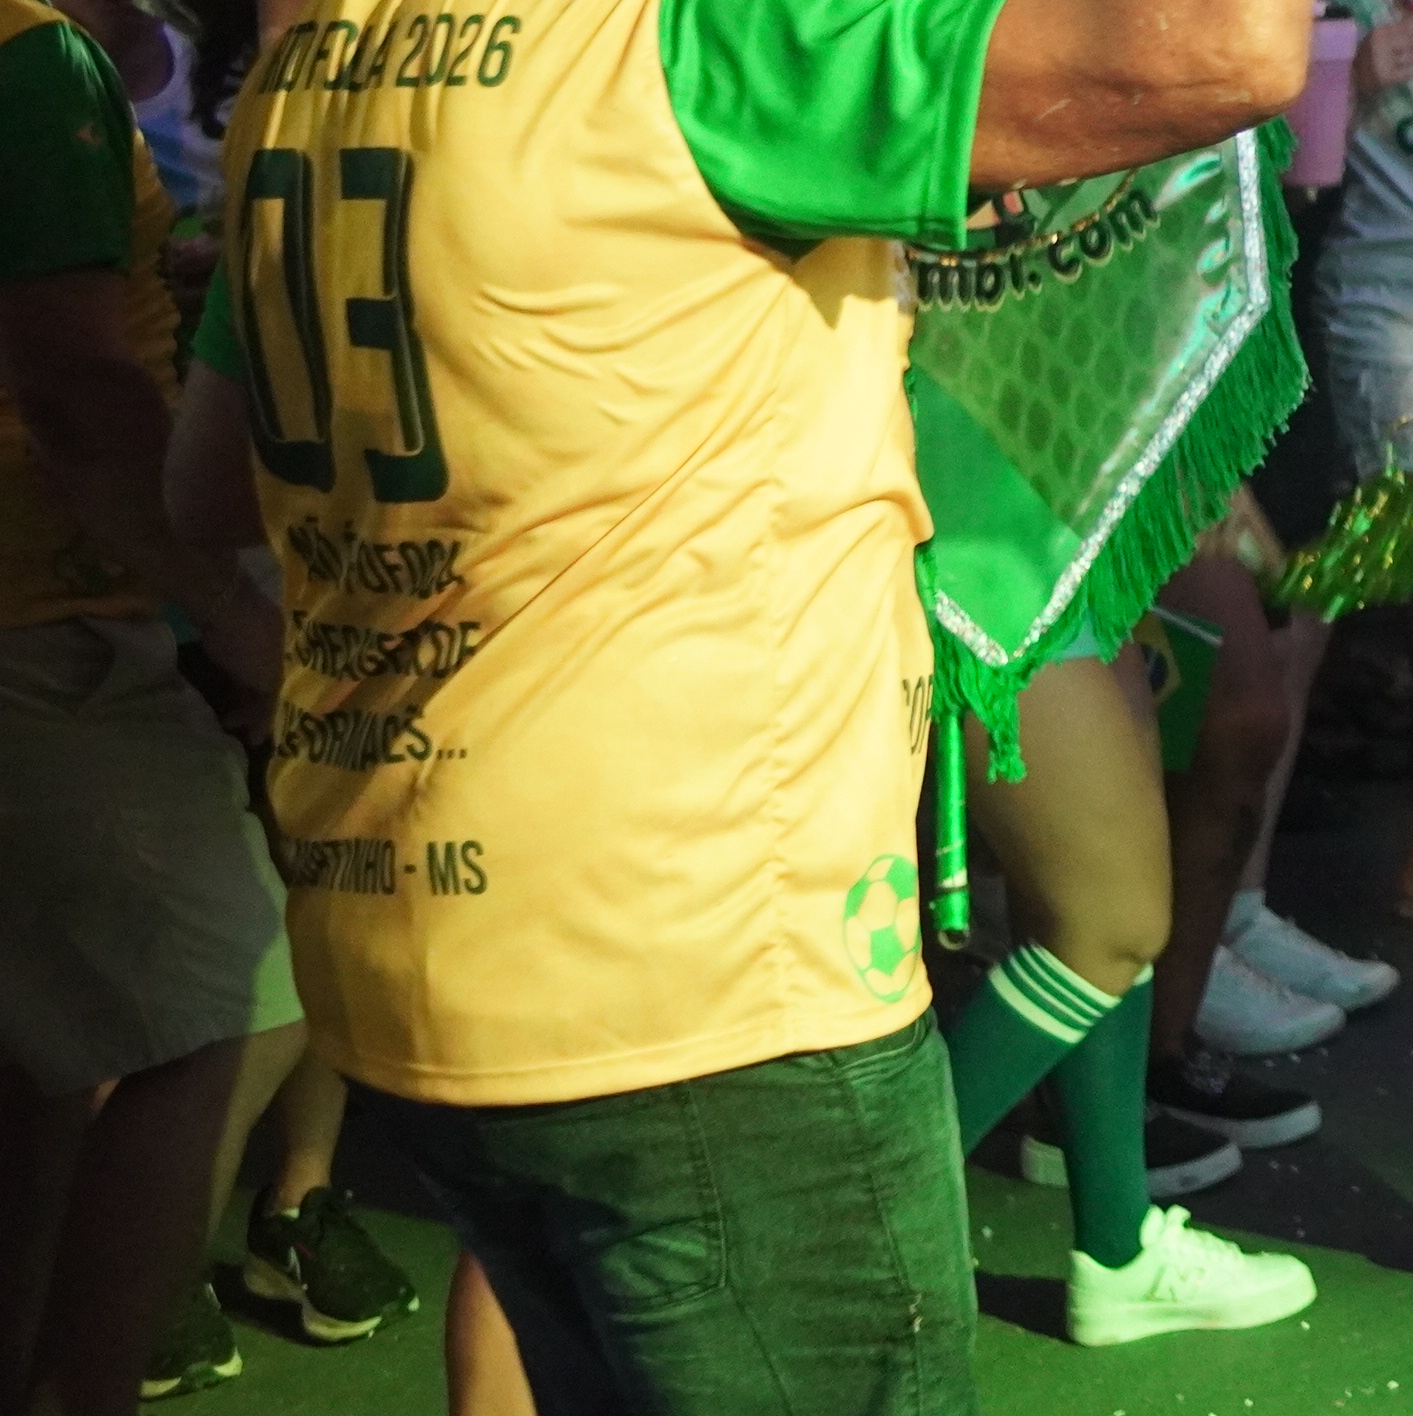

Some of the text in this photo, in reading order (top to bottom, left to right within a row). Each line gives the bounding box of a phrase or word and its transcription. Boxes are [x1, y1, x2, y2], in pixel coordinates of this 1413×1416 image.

[396, 13, 522, 88] 2026
[240, 147, 450, 504] 03
[426, 839, 488, 896] MS
